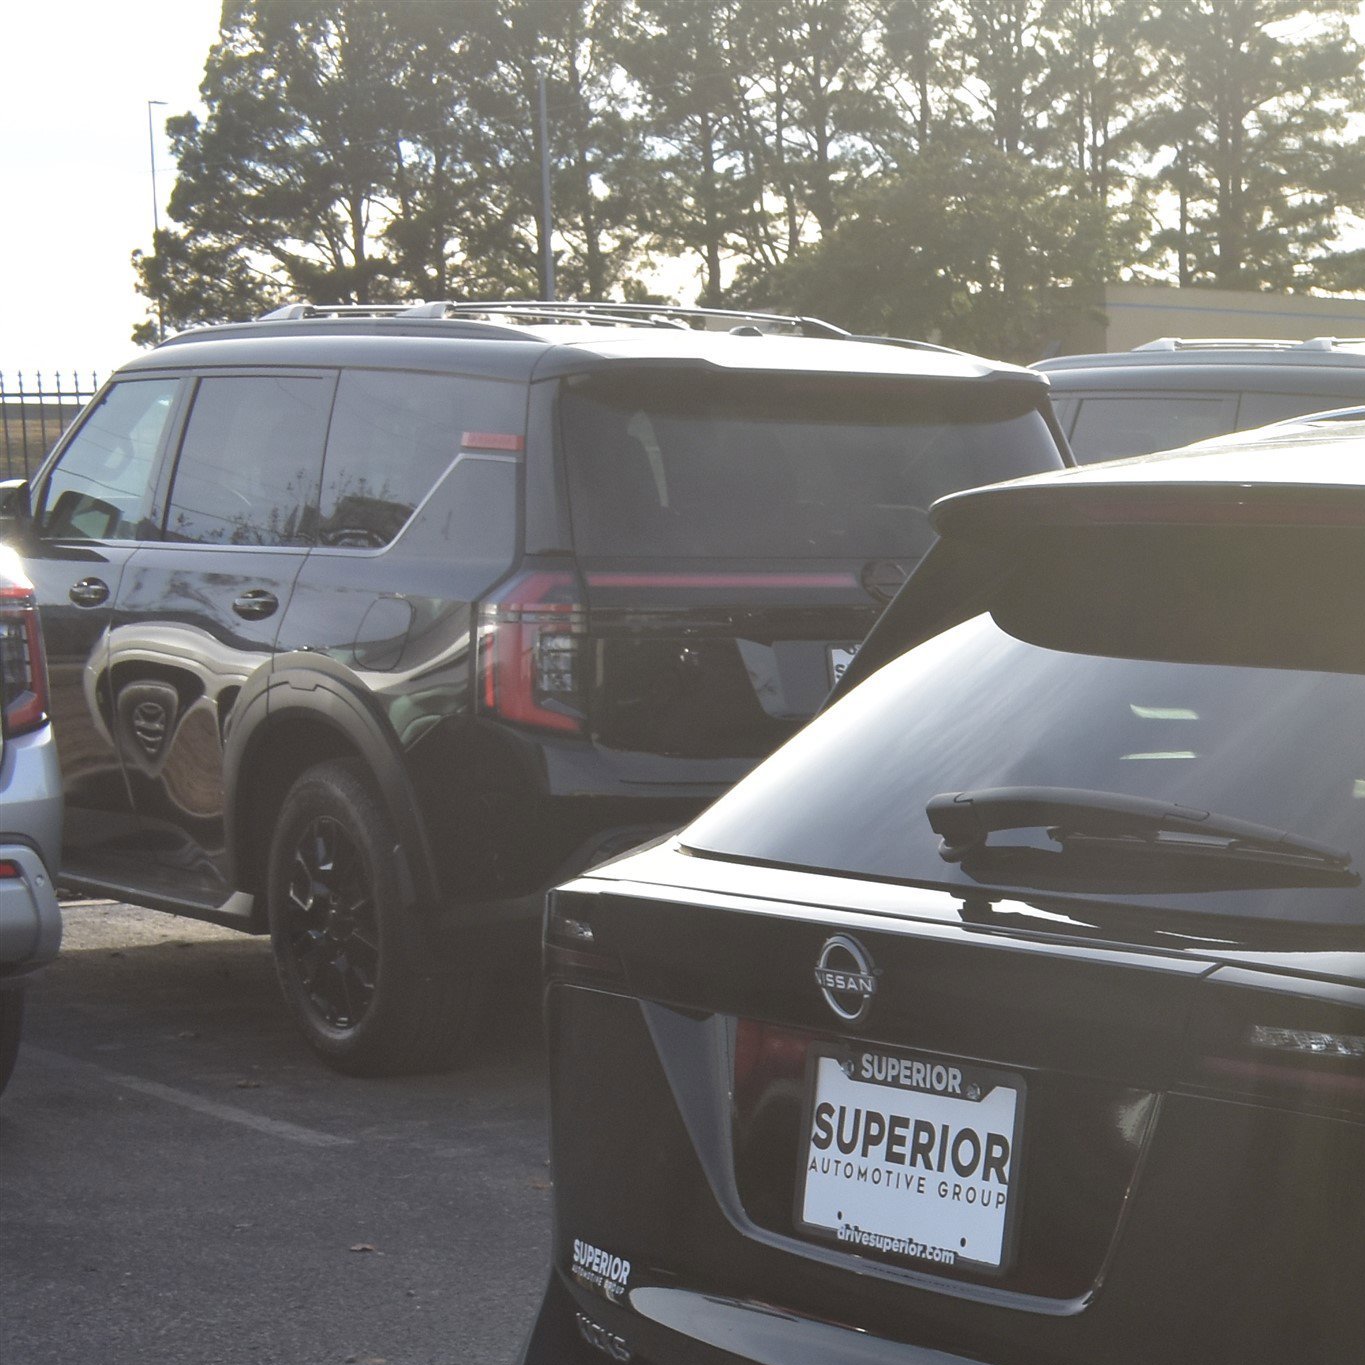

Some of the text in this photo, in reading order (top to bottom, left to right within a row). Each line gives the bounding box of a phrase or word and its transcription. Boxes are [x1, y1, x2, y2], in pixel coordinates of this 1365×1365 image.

[815, 967, 876, 993] NISSAN
[861, 1053, 962, 1093] SUPERIOR
[811, 1102, 1010, 1185] SUPERIOR
[808, 1158, 1006, 1209] AUTOMOTIVE GROUP
[573, 1239, 630, 1285] SUPERIOR
[837, 1224, 955, 1264] drivesuperior.com
